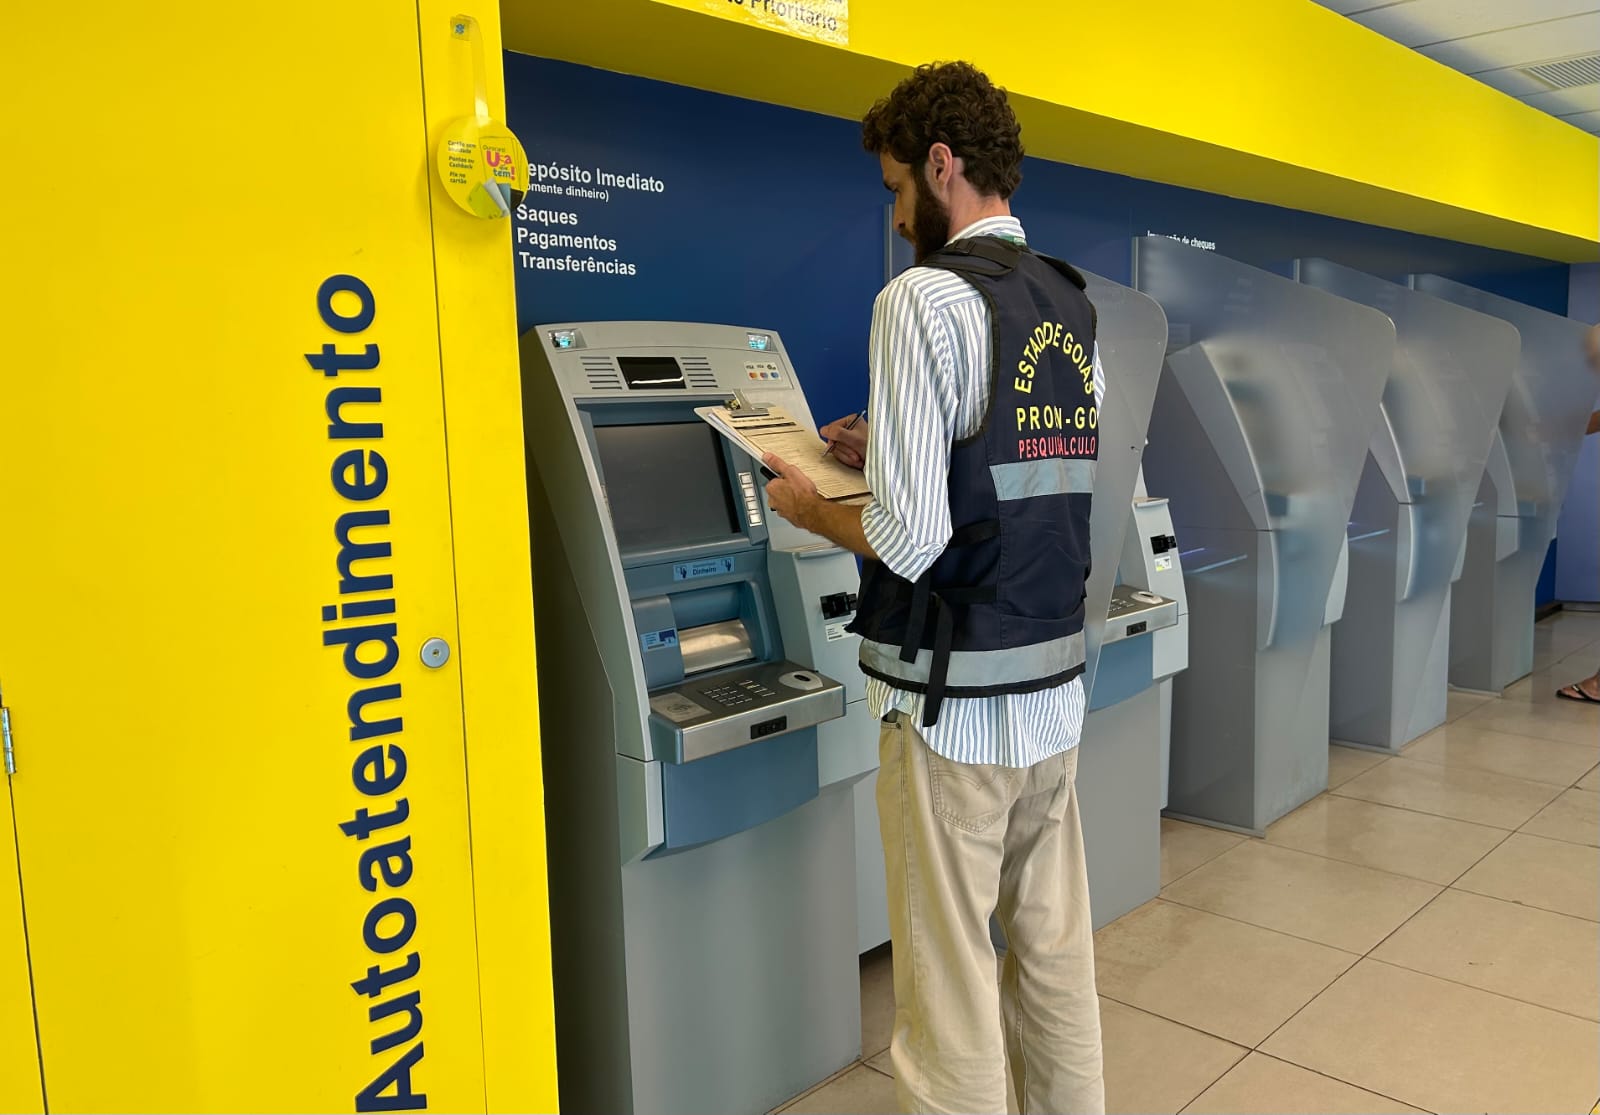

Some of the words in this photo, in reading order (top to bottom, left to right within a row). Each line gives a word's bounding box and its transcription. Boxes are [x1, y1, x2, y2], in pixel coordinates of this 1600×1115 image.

[528, 161, 592, 184] epósito
[596, 167, 665, 193] Imediato
[527, 183, 563, 195] omente
[566, 186, 609, 202] dinheiro)
[516, 203, 578, 226] Saques
[517, 227, 617, 251] Pagamentos
[518, 251, 636, 276] Transferências
[304, 274, 428, 1113] Autoatendimento
